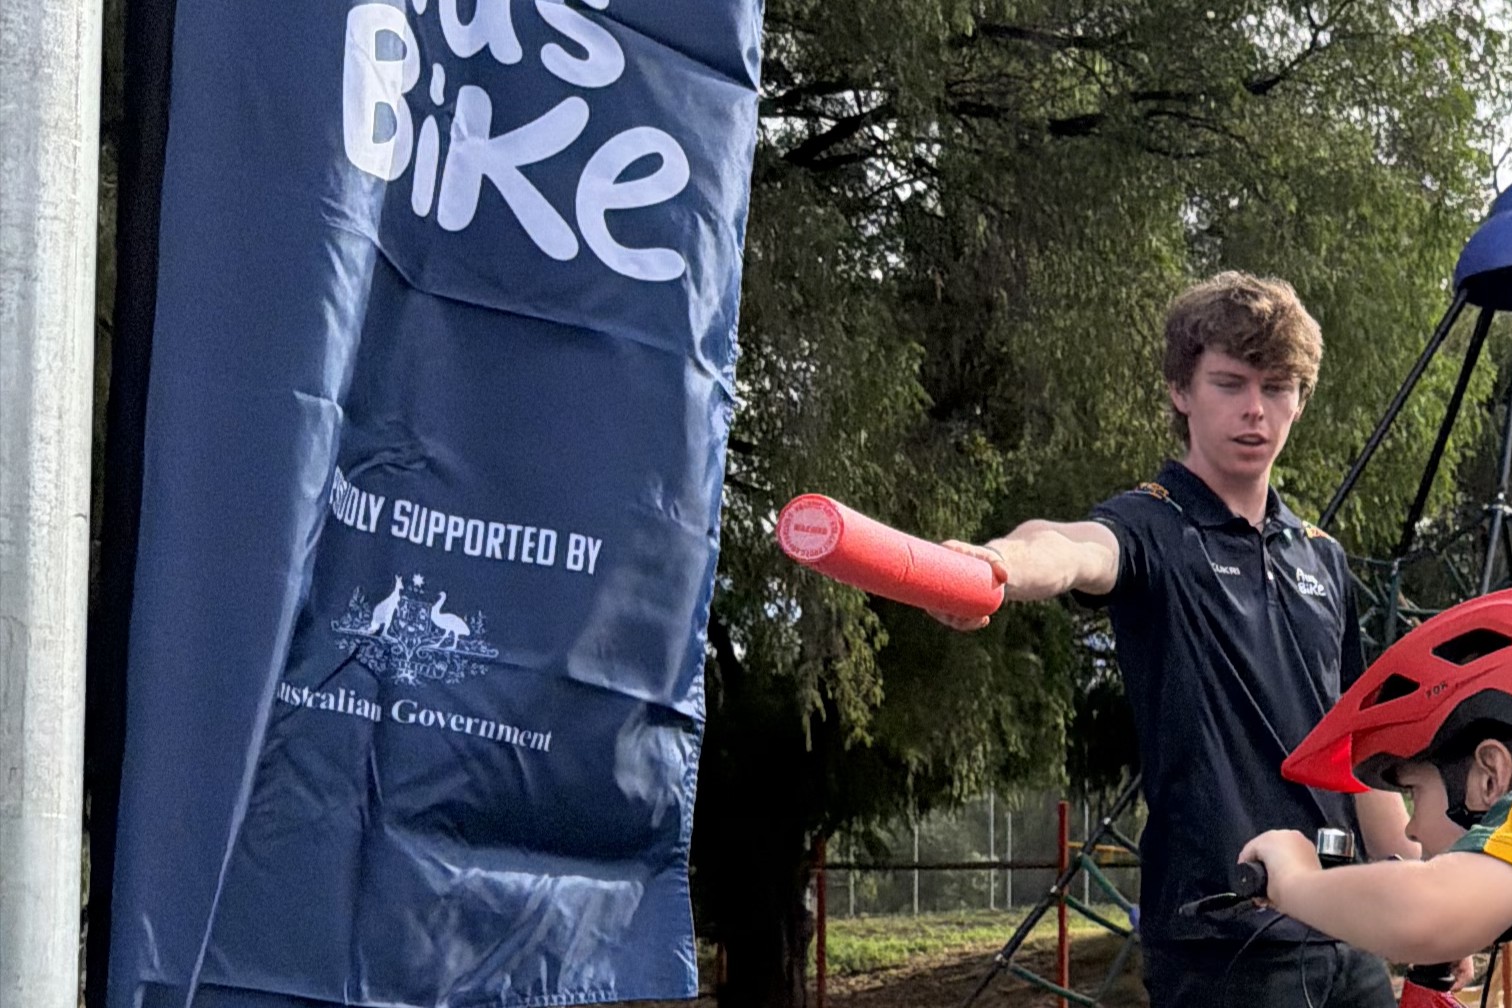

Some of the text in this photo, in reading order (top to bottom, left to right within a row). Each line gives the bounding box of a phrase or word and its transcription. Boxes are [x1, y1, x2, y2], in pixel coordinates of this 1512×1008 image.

[413, 0, 626, 88] us
[390, 498, 558, 567] SUPPORTED
[566, 532, 603, 575] BY
[277, 682, 553, 753] ustralian Government
